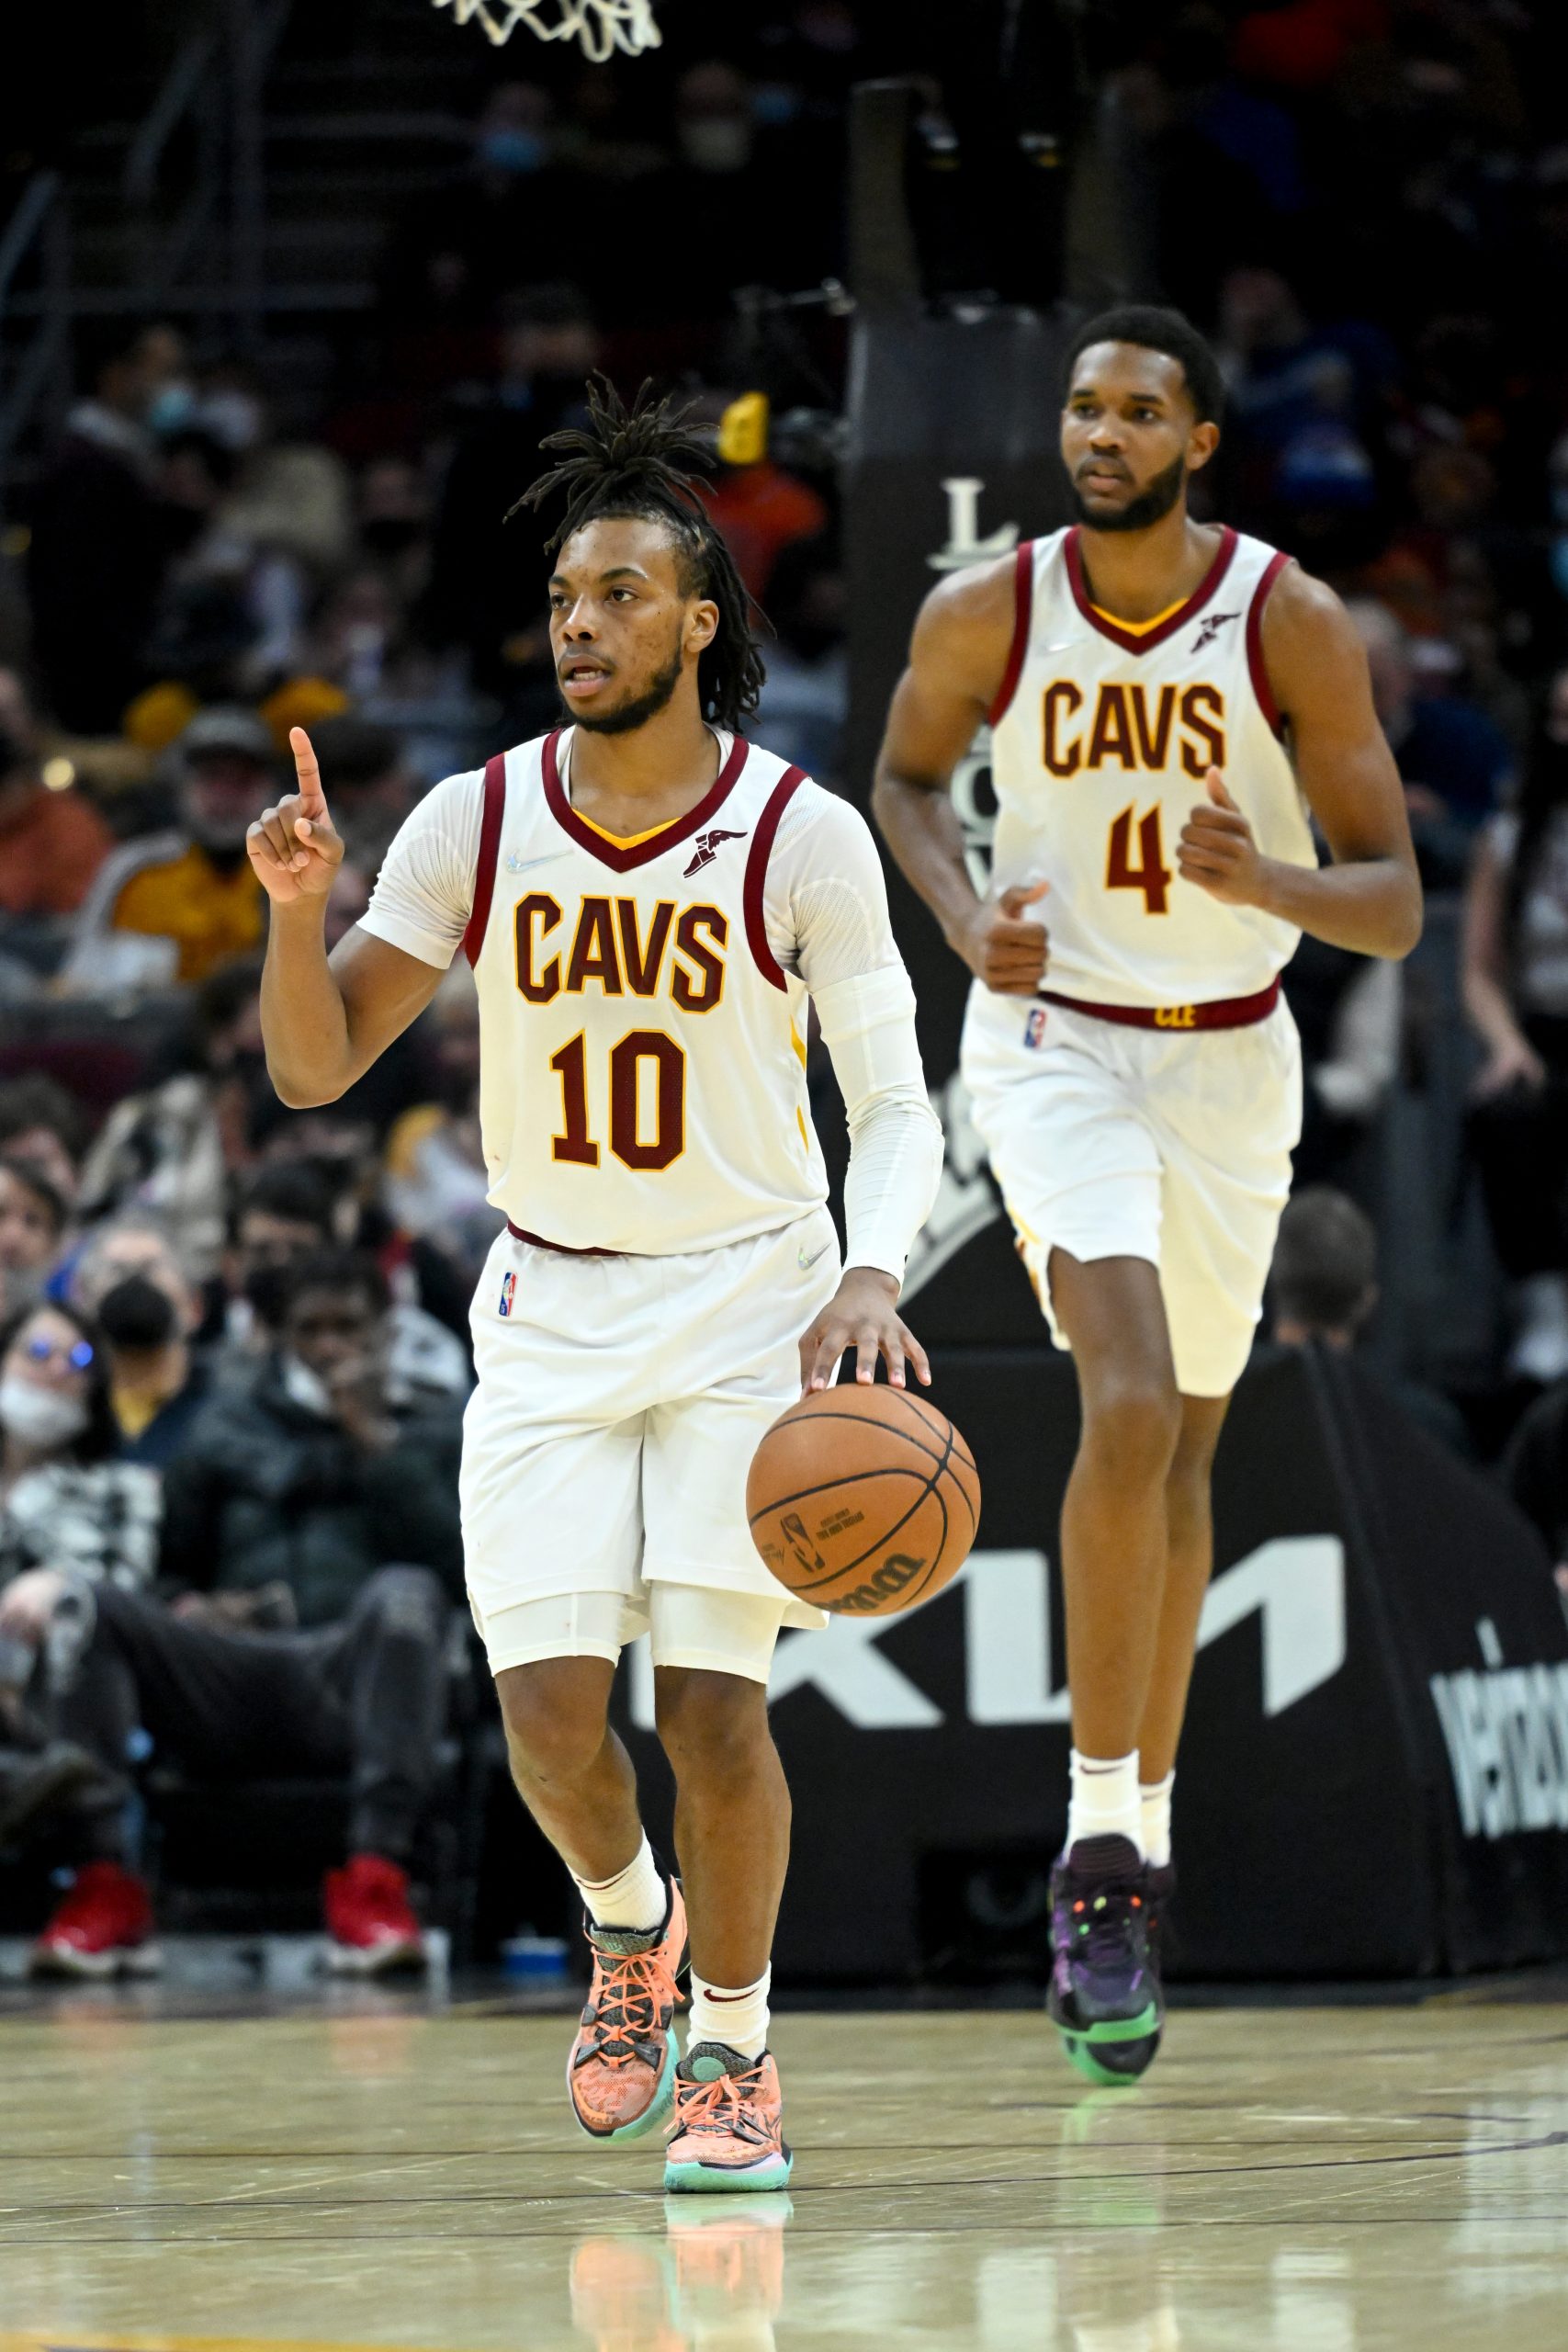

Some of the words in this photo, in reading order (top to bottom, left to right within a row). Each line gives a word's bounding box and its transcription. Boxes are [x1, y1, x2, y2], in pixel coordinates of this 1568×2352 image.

[1042, 679, 1226, 781] CAVS
[1105, 797, 1173, 916] 4
[513, 891, 730, 1015] CAVS
[1154, 1004, 1196, 1027] CLE
[549, 1027, 687, 1172] 10
